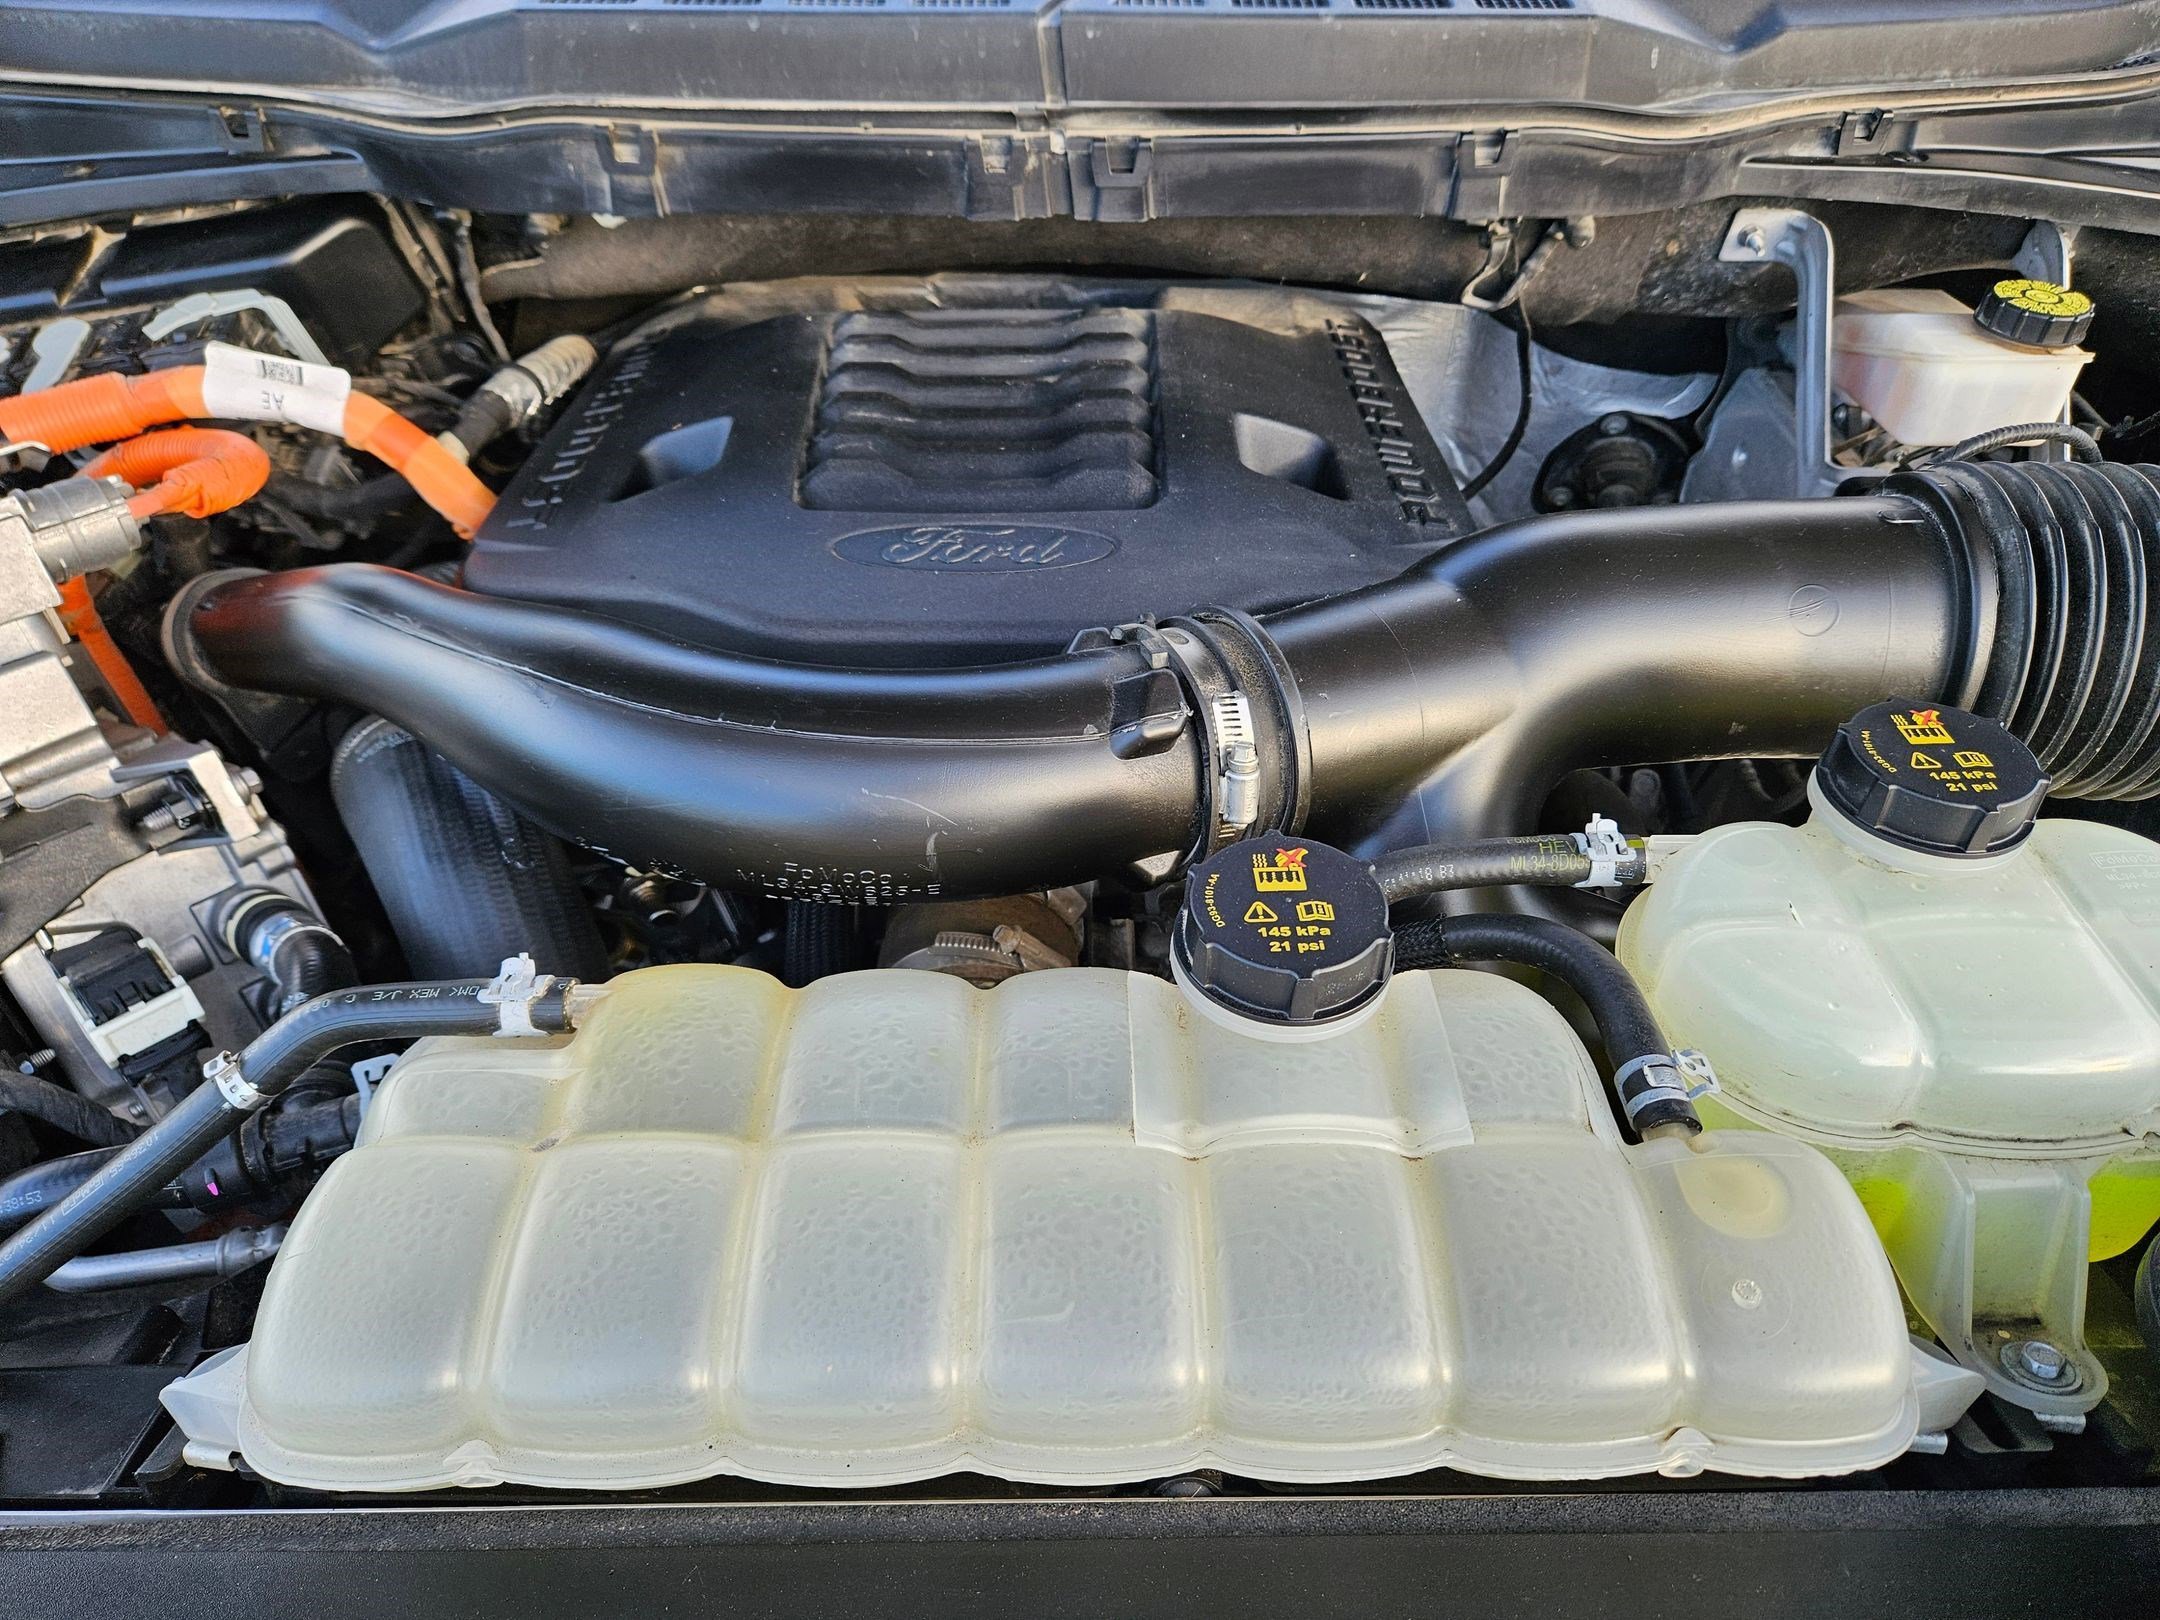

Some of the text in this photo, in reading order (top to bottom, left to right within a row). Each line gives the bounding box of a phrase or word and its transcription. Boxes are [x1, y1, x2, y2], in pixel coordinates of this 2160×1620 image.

[881, 526, 1067, 564] Ford
[1929, 769, 1997, 781] 145 kPa
[1945, 781, 1998, 793] 21 psi
[1257, 925, 1332, 937] 145 kPa
[1269, 940, 1326, 954] 21 psi
[408, 987, 440, 999] MEX
